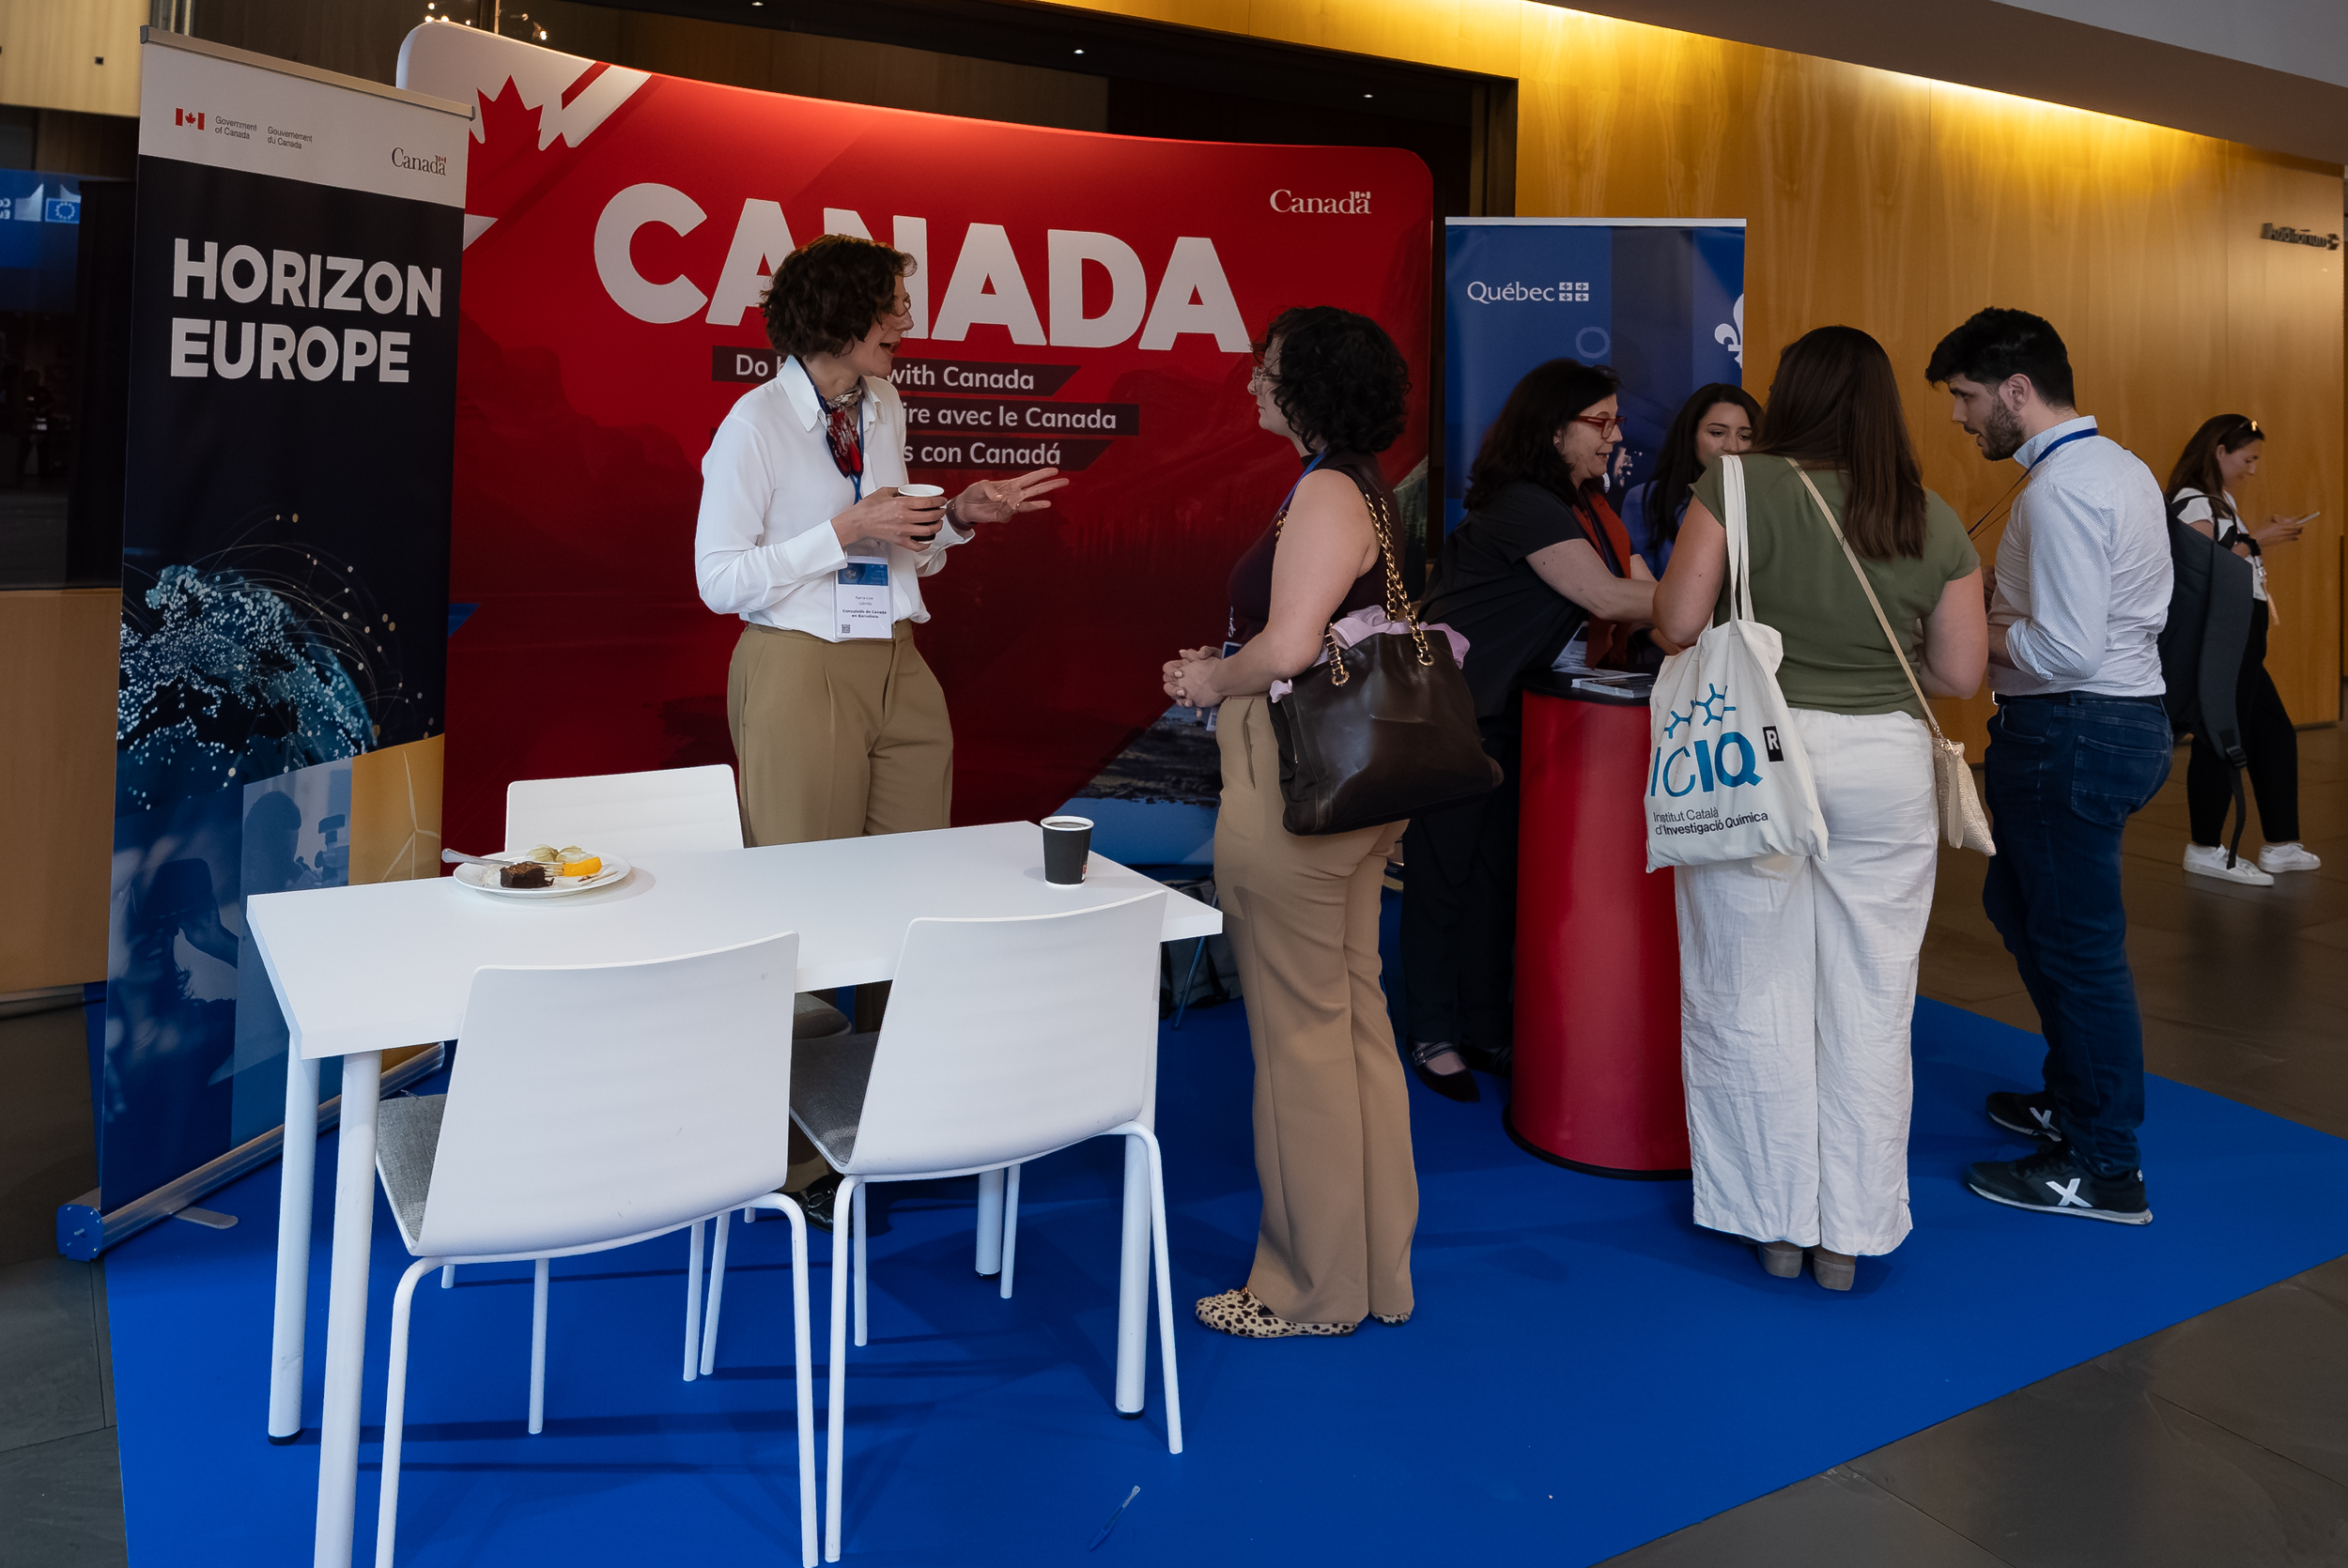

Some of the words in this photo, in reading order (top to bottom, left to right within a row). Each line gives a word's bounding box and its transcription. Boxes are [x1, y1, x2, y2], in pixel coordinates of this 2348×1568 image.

[214, 126, 223, 134] of
[224, 128, 251, 140] Canada
[215, 115, 257, 131] Government
[268, 126, 313, 142] Gouvernement
[277, 138, 302, 149] Canada
[391, 146, 447, 176] Canada
[1270, 189, 1371, 214] Canada
[173, 238, 441, 317] HORIZON
[1467, 281, 1555, 304] Québec
[171, 317, 410, 382] EUROPE
[735, 354, 768, 377] Do
[887, 363, 935, 386] with
[943, 366, 1034, 390] Canada
[937, 408, 992, 426] avec
[998, 406, 1018, 426] le
[1026, 407, 1117, 429] Canada
[920, 446, 962, 463] con
[969, 442, 1060, 465] Canadá
[1650, 731, 1764, 797] ICIQ
[1653, 810, 1686, 823] Institut
[1686, 807, 1720, 821] Català
[1655, 819, 1724, 836] d'Investigació
[1724, 812, 1769, 828] Química
